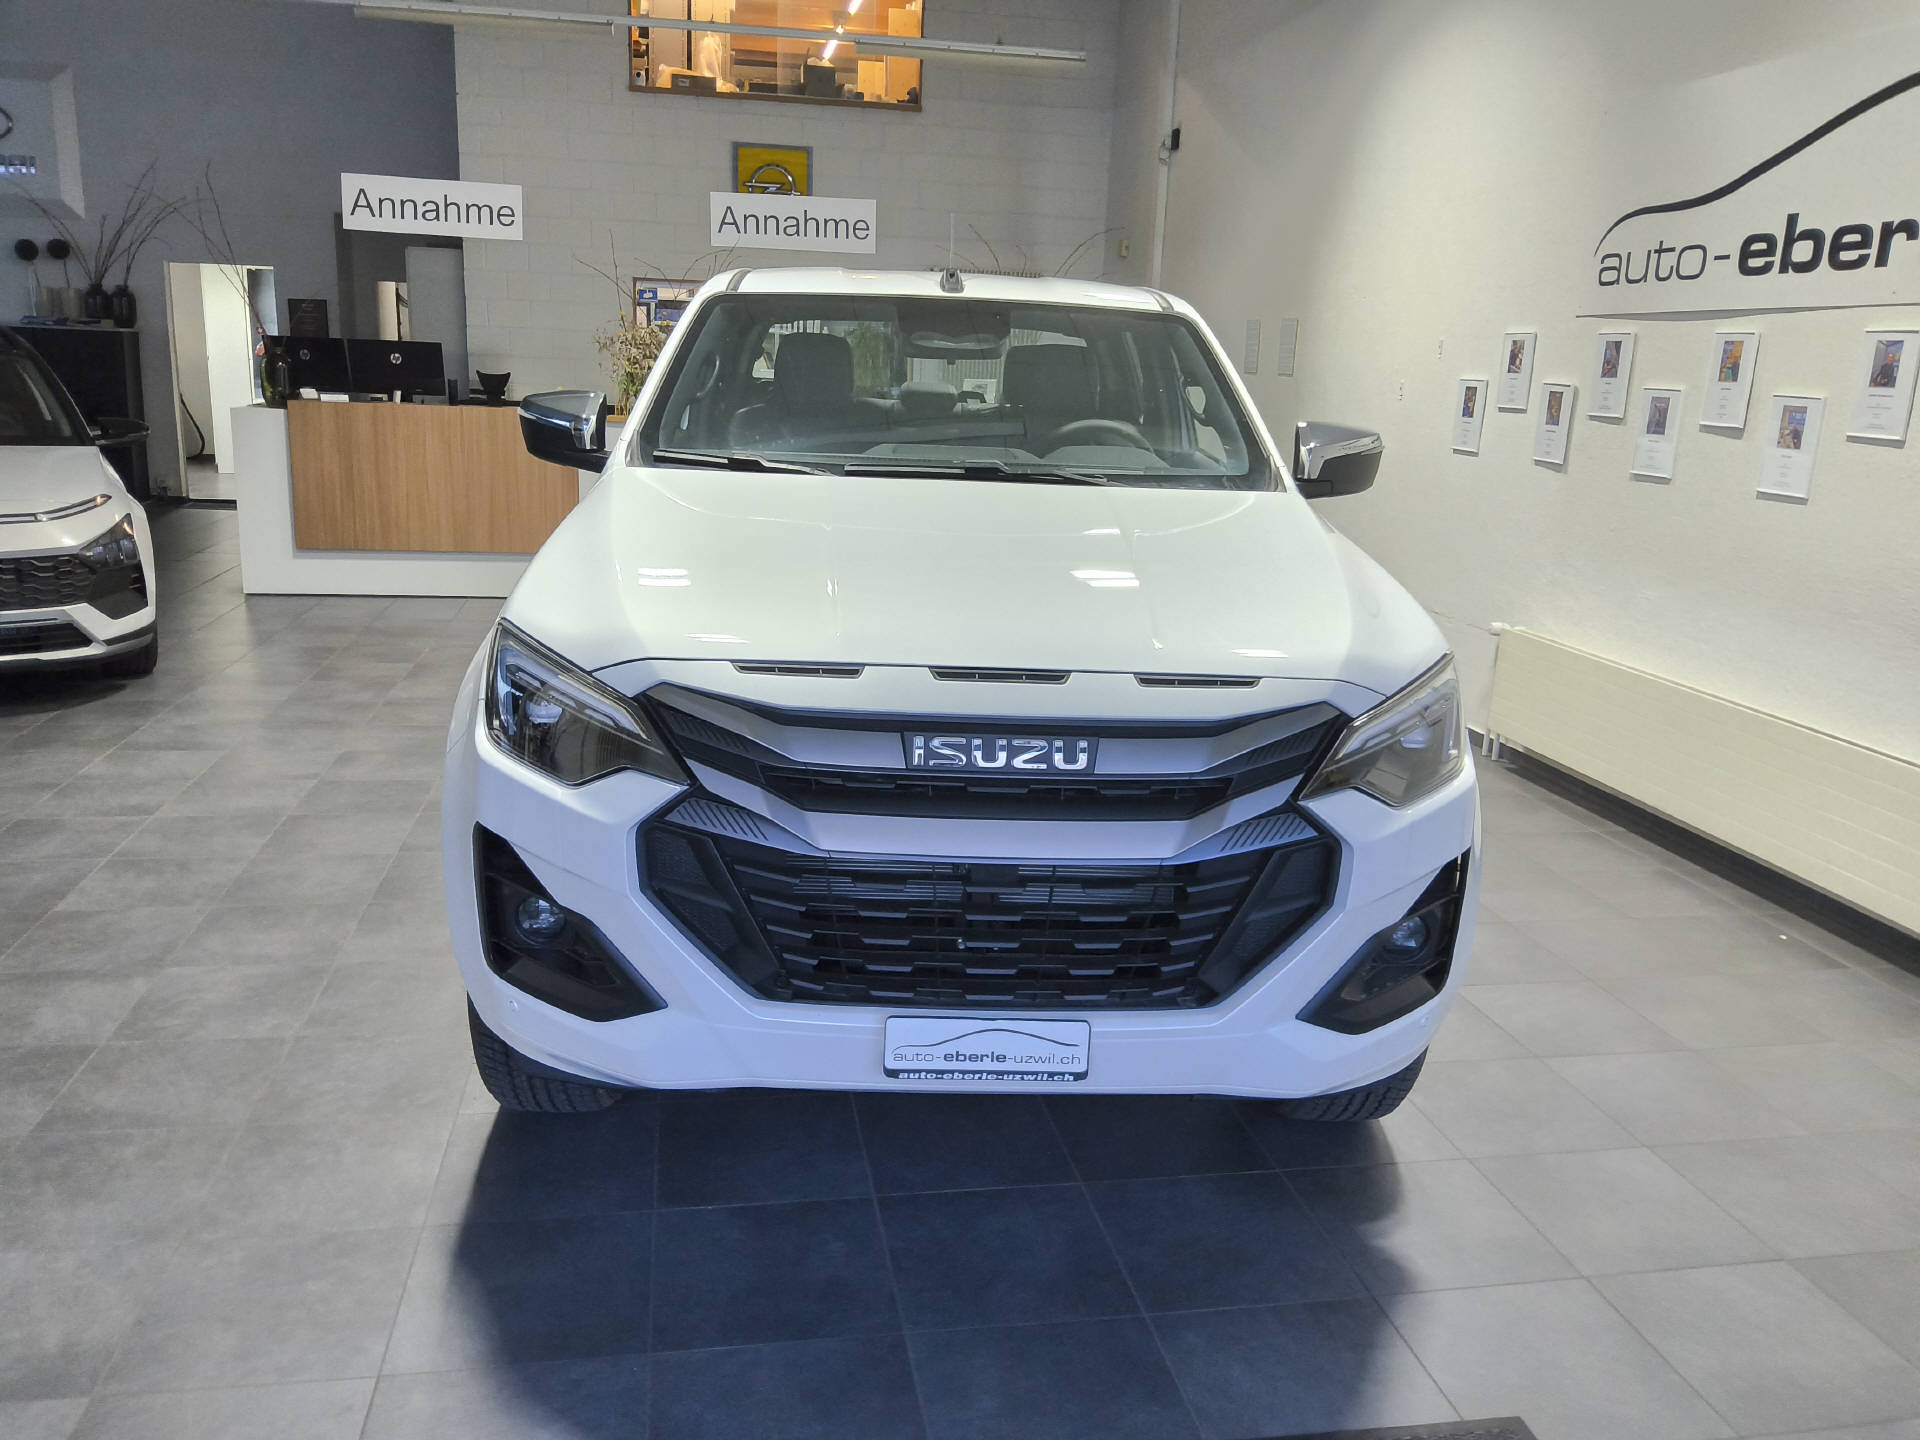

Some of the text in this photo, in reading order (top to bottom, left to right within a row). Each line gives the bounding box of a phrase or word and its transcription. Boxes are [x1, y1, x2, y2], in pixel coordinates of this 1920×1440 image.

[350, 188, 516, 227] Annahme
[717, 205, 870, 241] Annahme
[912, 735, 1089, 770] ISUZU
[893, 1050, 1081, 1066] auto-eberle-uzwil.ch
[898, 1071, 1074, 1082] auto-eberle-uzwil.ch
